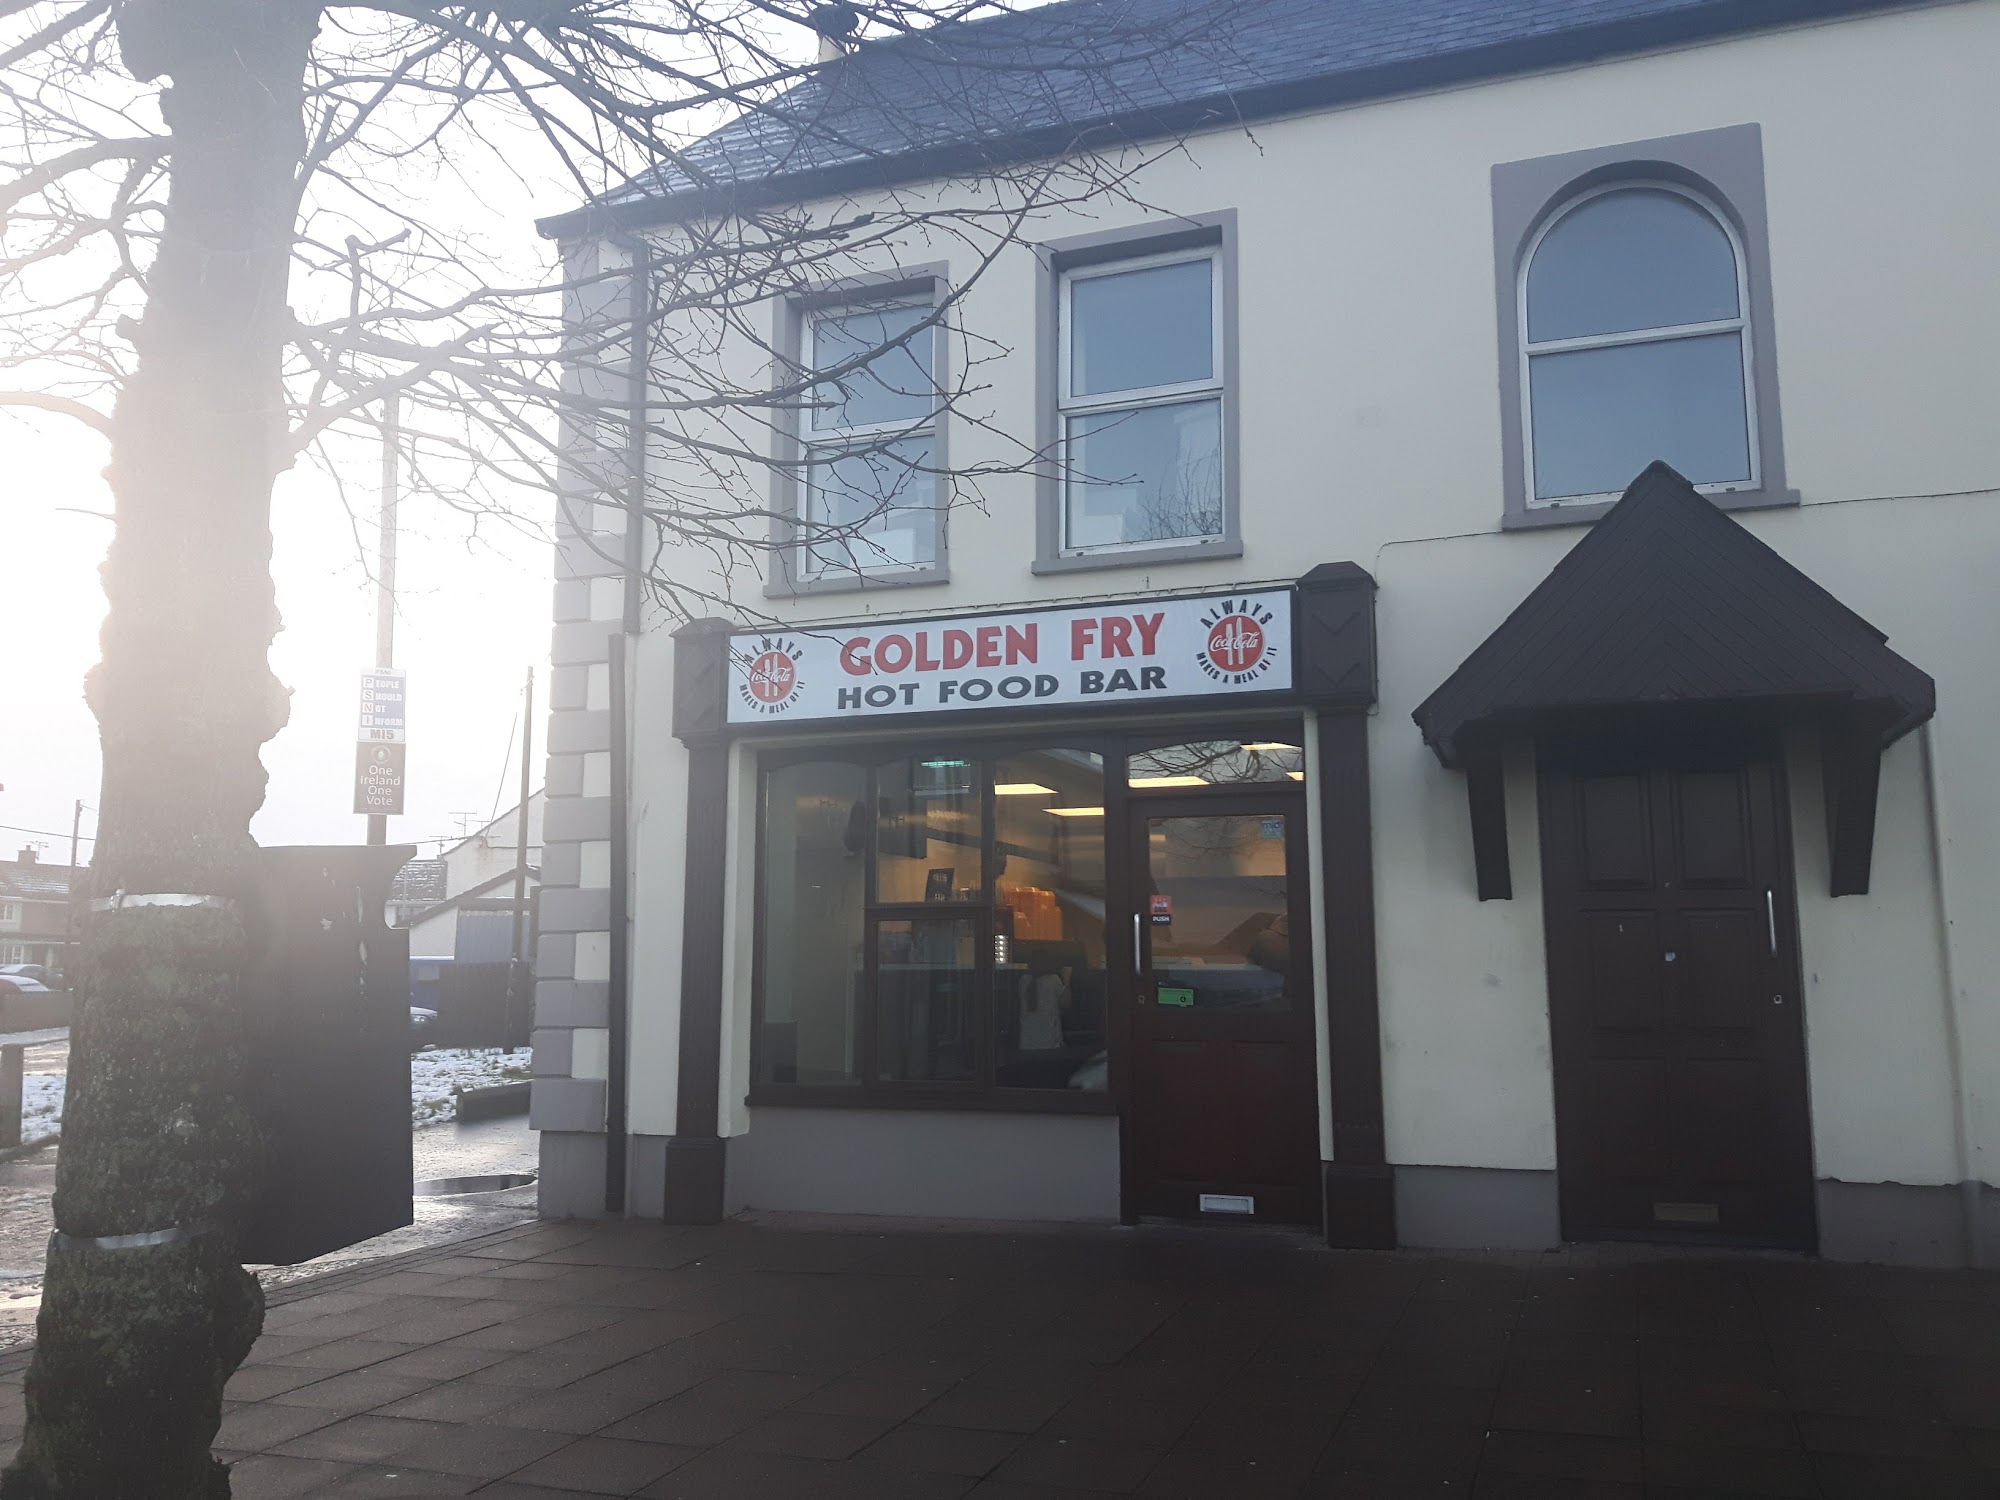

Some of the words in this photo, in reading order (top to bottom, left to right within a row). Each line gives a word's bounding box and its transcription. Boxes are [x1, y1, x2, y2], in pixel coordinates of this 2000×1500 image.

[1200, 599, 1273, 629] ALWAYS
[744, 637, 803, 664] ALWAYS
[839, 622, 1038, 676] GOLDEN
[1071, 612, 1166, 661] FRY
[1196, 652, 1221, 680] MAKES
[1222, 674, 1229, 684] A
[1234, 669, 1259, 684] MEAL
[1258, 658, 1271, 672] OF
[1266, 646, 1278, 657] IT
[739, 684, 758, 710] MAKES
[760, 704, 765, 713] A
[769, 701, 790, 714] MEAL
[790, 691, 800, 702] OF
[796, 680, 806, 690] IT
[837, 682, 920, 710] HOT
[938, 674, 1059, 703] FOOD
[1080, 666, 1168, 695] BAR
[370, 728, 395, 740] MI5
[368, 765, 393, 776] One
[360, 775, 401, 786] Ireland
[367, 785, 392, 796] One
[365, 795, 393, 806] Vote
[1152, 915, 1170, 923] PUSH
